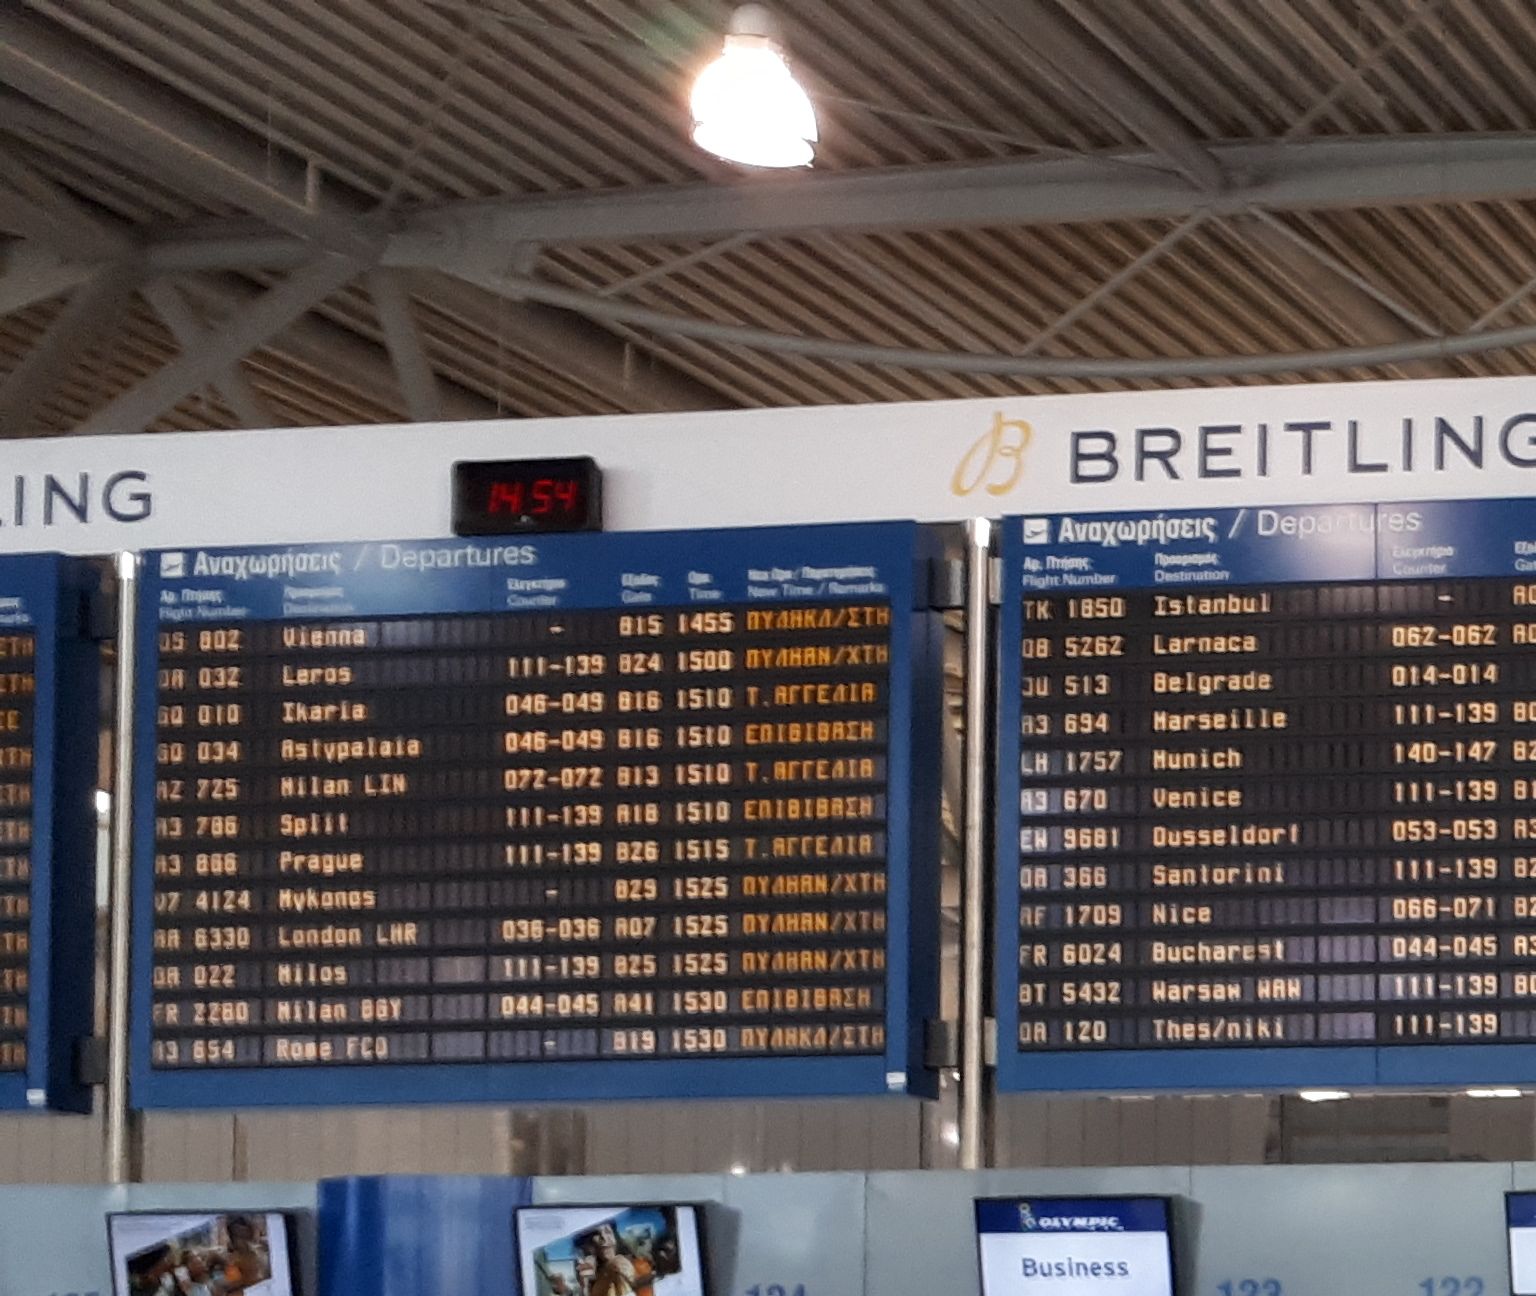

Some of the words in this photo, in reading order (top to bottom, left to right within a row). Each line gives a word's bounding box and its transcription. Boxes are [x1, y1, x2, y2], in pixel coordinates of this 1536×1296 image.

[0, 470, 153, 527] ING
[1058, 517, 1218, 547] Αναχωρήσεις
[1257, 508, 1423, 537] Departures
[194, 549, 342, 580] Αναχωρήσεις
[381, 543, 536, 571] Departures
[1022, 574, 1062, 588] Flight
[1063, 571, 1118, 585] Number
[1154, 569, 1231, 583] Destination
[1154, 593, 1270, 618] Istanbul
[1153, 632, 1255, 657] Larnaca
[1153, 670, 1270, 699] Belgrade
[1153, 708, 1284, 734] Marseille
[1153, 748, 1240, 772] Munich
[1153, 787, 1240, 810] Venice
[1153, 823, 1299, 849] Dusseldorf
[1153, 862, 1284, 888] Santorini
[1152, 903, 1210, 926] Nice
[1152, 939, 1284, 965] Bucharest
[1152, 979, 1239, 1003] Warsaw
[1255, 978, 1298, 1000] WAW
[1152, 1016, 1283, 1042] Thes/niki
[1038, 1215, 1120, 1229] OLYMPIC
[1021, 1256, 1130, 1278] Business
